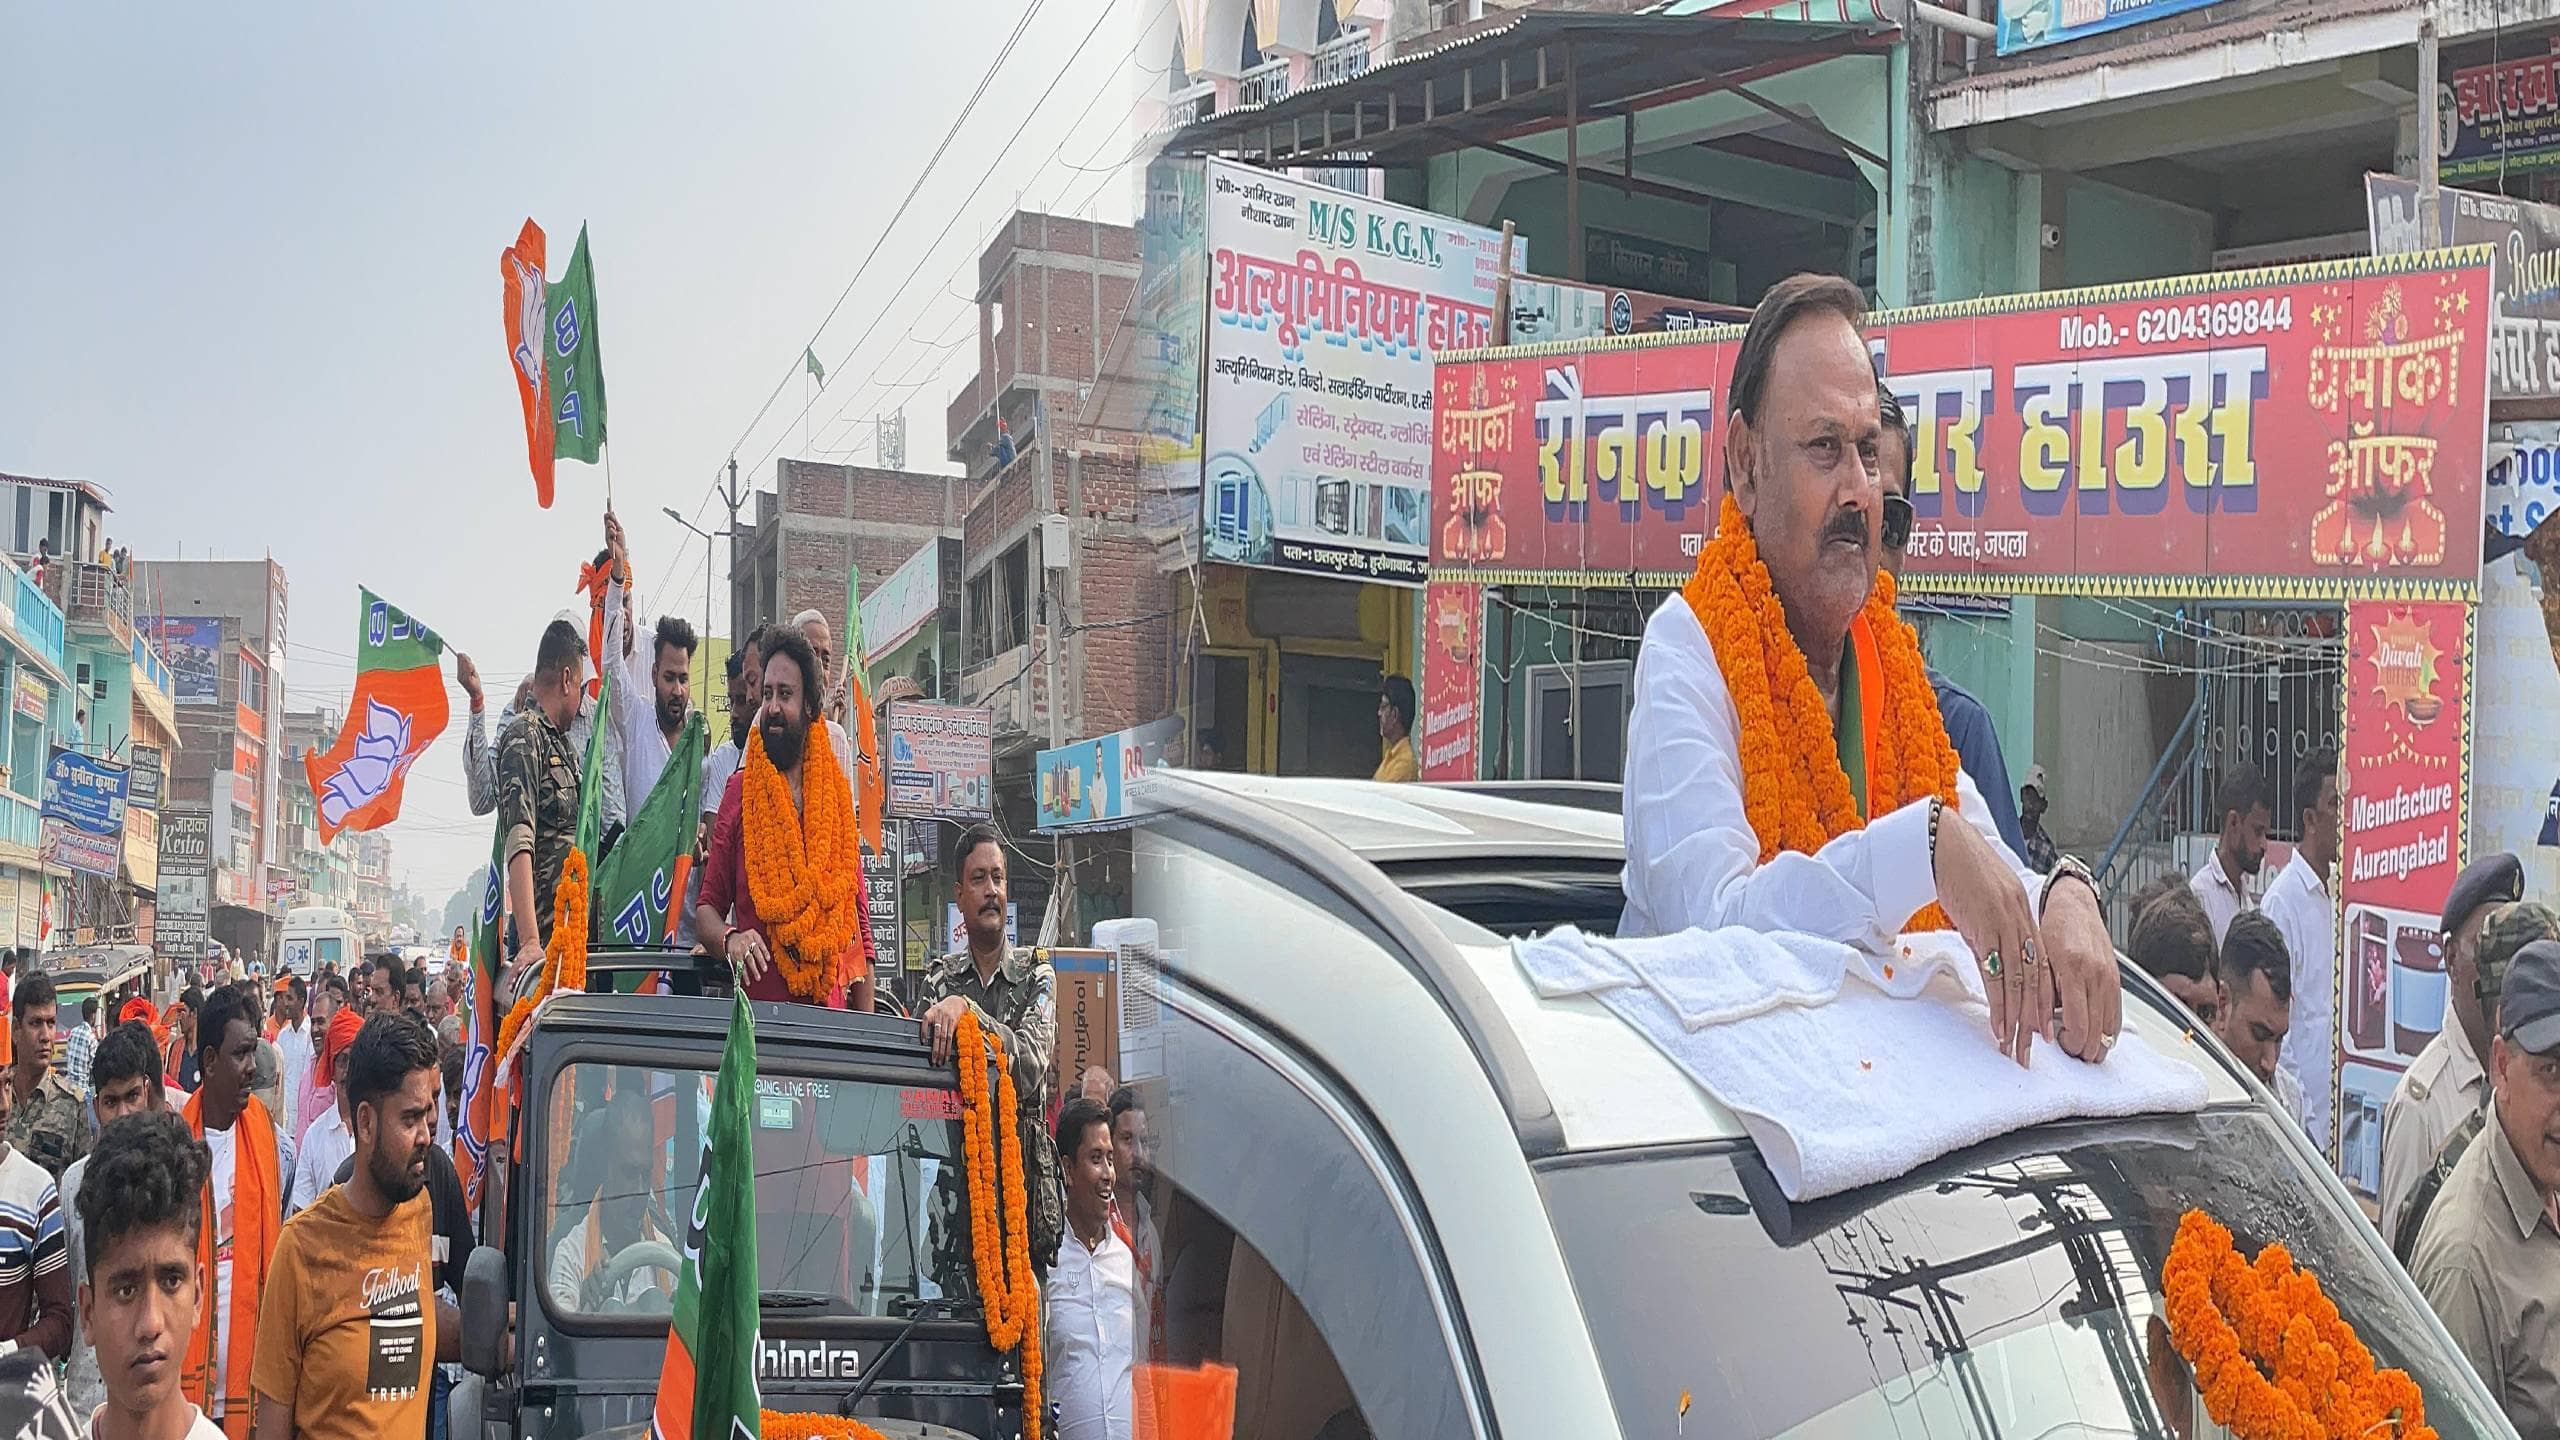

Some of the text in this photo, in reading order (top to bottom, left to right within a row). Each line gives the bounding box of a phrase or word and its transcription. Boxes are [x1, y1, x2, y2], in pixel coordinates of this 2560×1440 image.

[1273, 213, 1295, 230] खान
[1274, 190, 1296, 209] खान
[1308, 199, 1444, 269] M/S K.G.N.
[1214, 248, 1421, 352] अल्यूमिनियम
[2136, 296, 2293, 346] 6204369844
[2307, 329, 2466, 413] धमाका
[1441, 401, 1516, 456] धमाका
[1534, 364, 1711, 508] रौनक
[2013, 345, 2268, 498] हाउस
[1303, 442, 1320, 464] एवं
[1324, 444, 1357, 468] रेलिंग
[1360, 450, 1390, 475] स्टील
[2326, 419, 2438, 497] ऑफर
[1450, 461, 1503, 513] ऑफर
[1930, 523, 1945, 557] के
[1984, 530, 2028, 559] जपला
[2381, 641, 2424, 668] Diwali
[95, 775, 120, 795] कुमार
[2351, 781, 2453, 834] Menufacture
[160, 824, 205, 855] Restro
[2351, 825, 2449, 883] Aurangabad
[784, 1079, 804, 1097] LIVE
[806, 1081, 831, 1099] FREE
[360, 1262, 422, 1309] Tailboat
[759, 1339, 860, 1378] hindra
[370, 1385, 417, 1402] TREND
